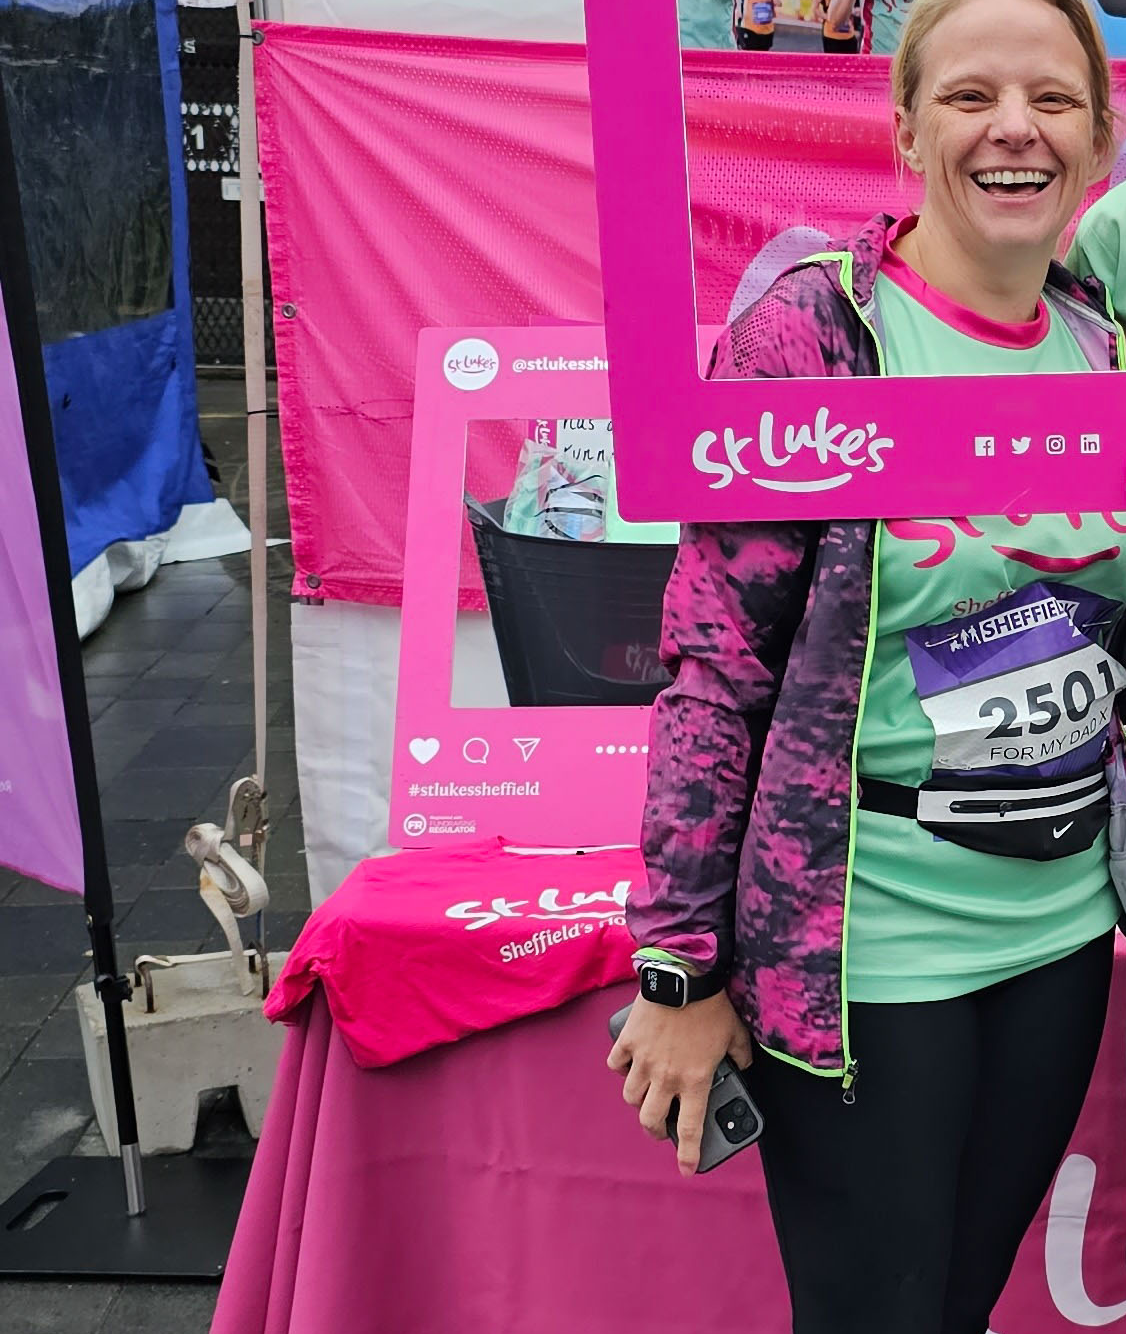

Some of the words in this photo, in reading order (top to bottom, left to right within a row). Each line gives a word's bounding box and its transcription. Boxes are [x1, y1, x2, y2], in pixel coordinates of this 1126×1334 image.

[693, 427, 753, 489] St
[759, 406, 894, 472] Luke's
[979, 659, 1116, 740] 2501
[990, 746, 1034, 761] FOR
[1040, 735, 1067, 757] MY
[1069, 719, 1098, 745] DAD
[1098, 708, 1108, 725] X
[408, 781, 540, 797] #stlukessheffield
[429, 826, 476, 834] REGULATOR
[445, 898, 529, 931] St
[499, 922, 594, 963] Sheffield's
